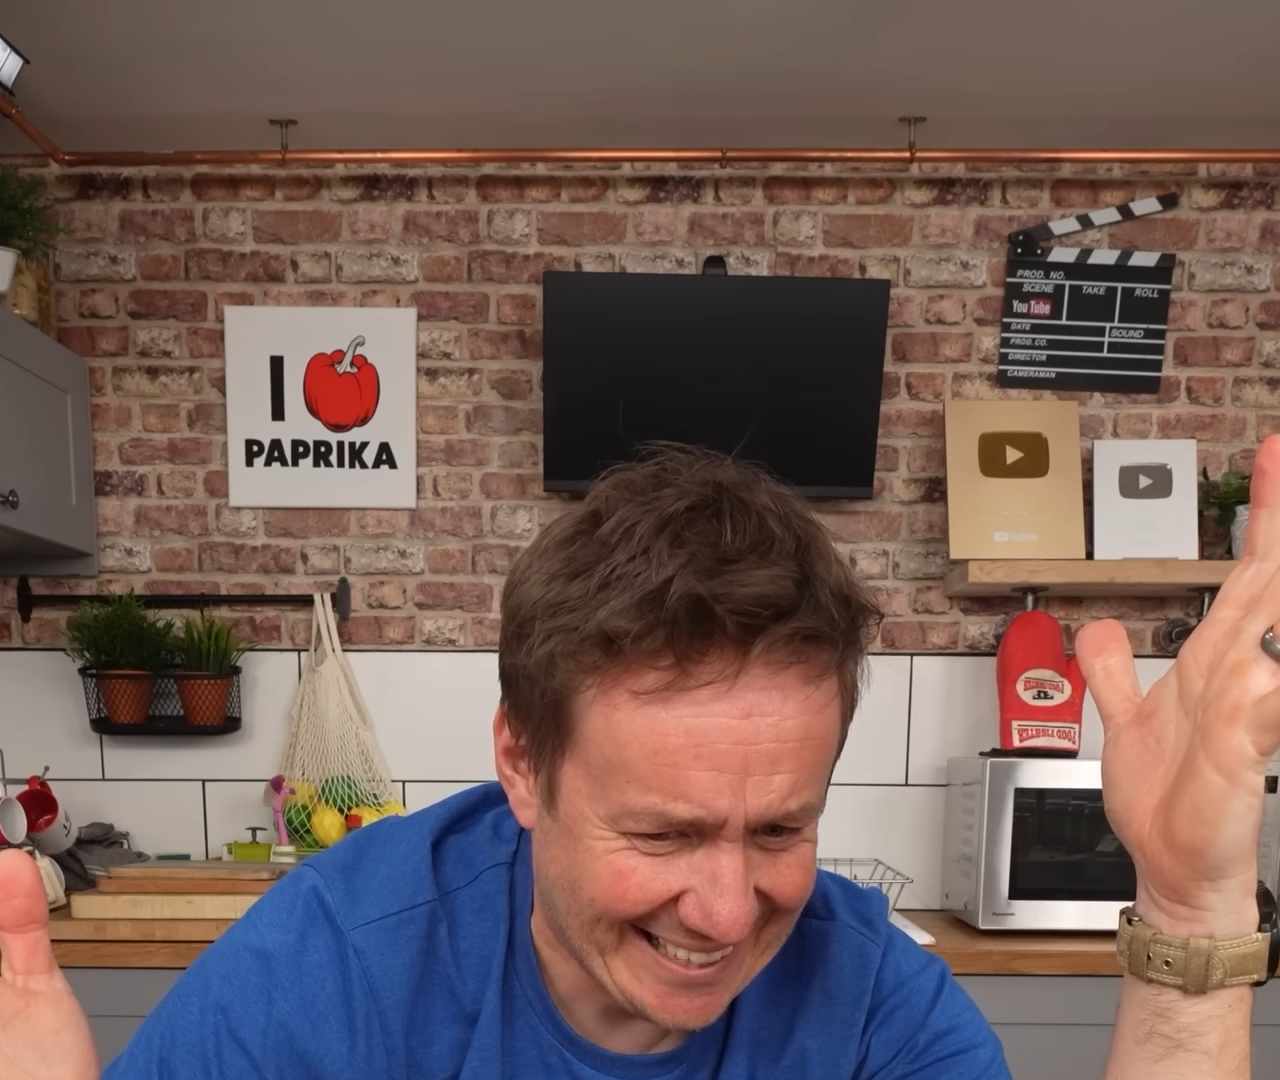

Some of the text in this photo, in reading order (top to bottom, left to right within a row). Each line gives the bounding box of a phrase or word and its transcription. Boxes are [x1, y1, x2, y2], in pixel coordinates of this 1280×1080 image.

[1016, 269, 1067, 280] PROD. NO.
[1022, 283, 1055, 293] SCENE
[1082, 286, 1106, 295] TAKE
[1134, 288, 1159, 298] ROLL
[1011, 323, 1031, 331] DATE
[1111, 329, 1144, 338] SOUND
[1010, 338, 1033, 346] PROD.
[1008, 353, 1047, 361] DIRECTOR
[1007, 370, 1056, 378] CAMERAMAN
[270, 355, 285, 422] I
[244, 438, 398, 470] PAPRIKA
[1017, 727, 1077, 745] FOOD FIGHTER
